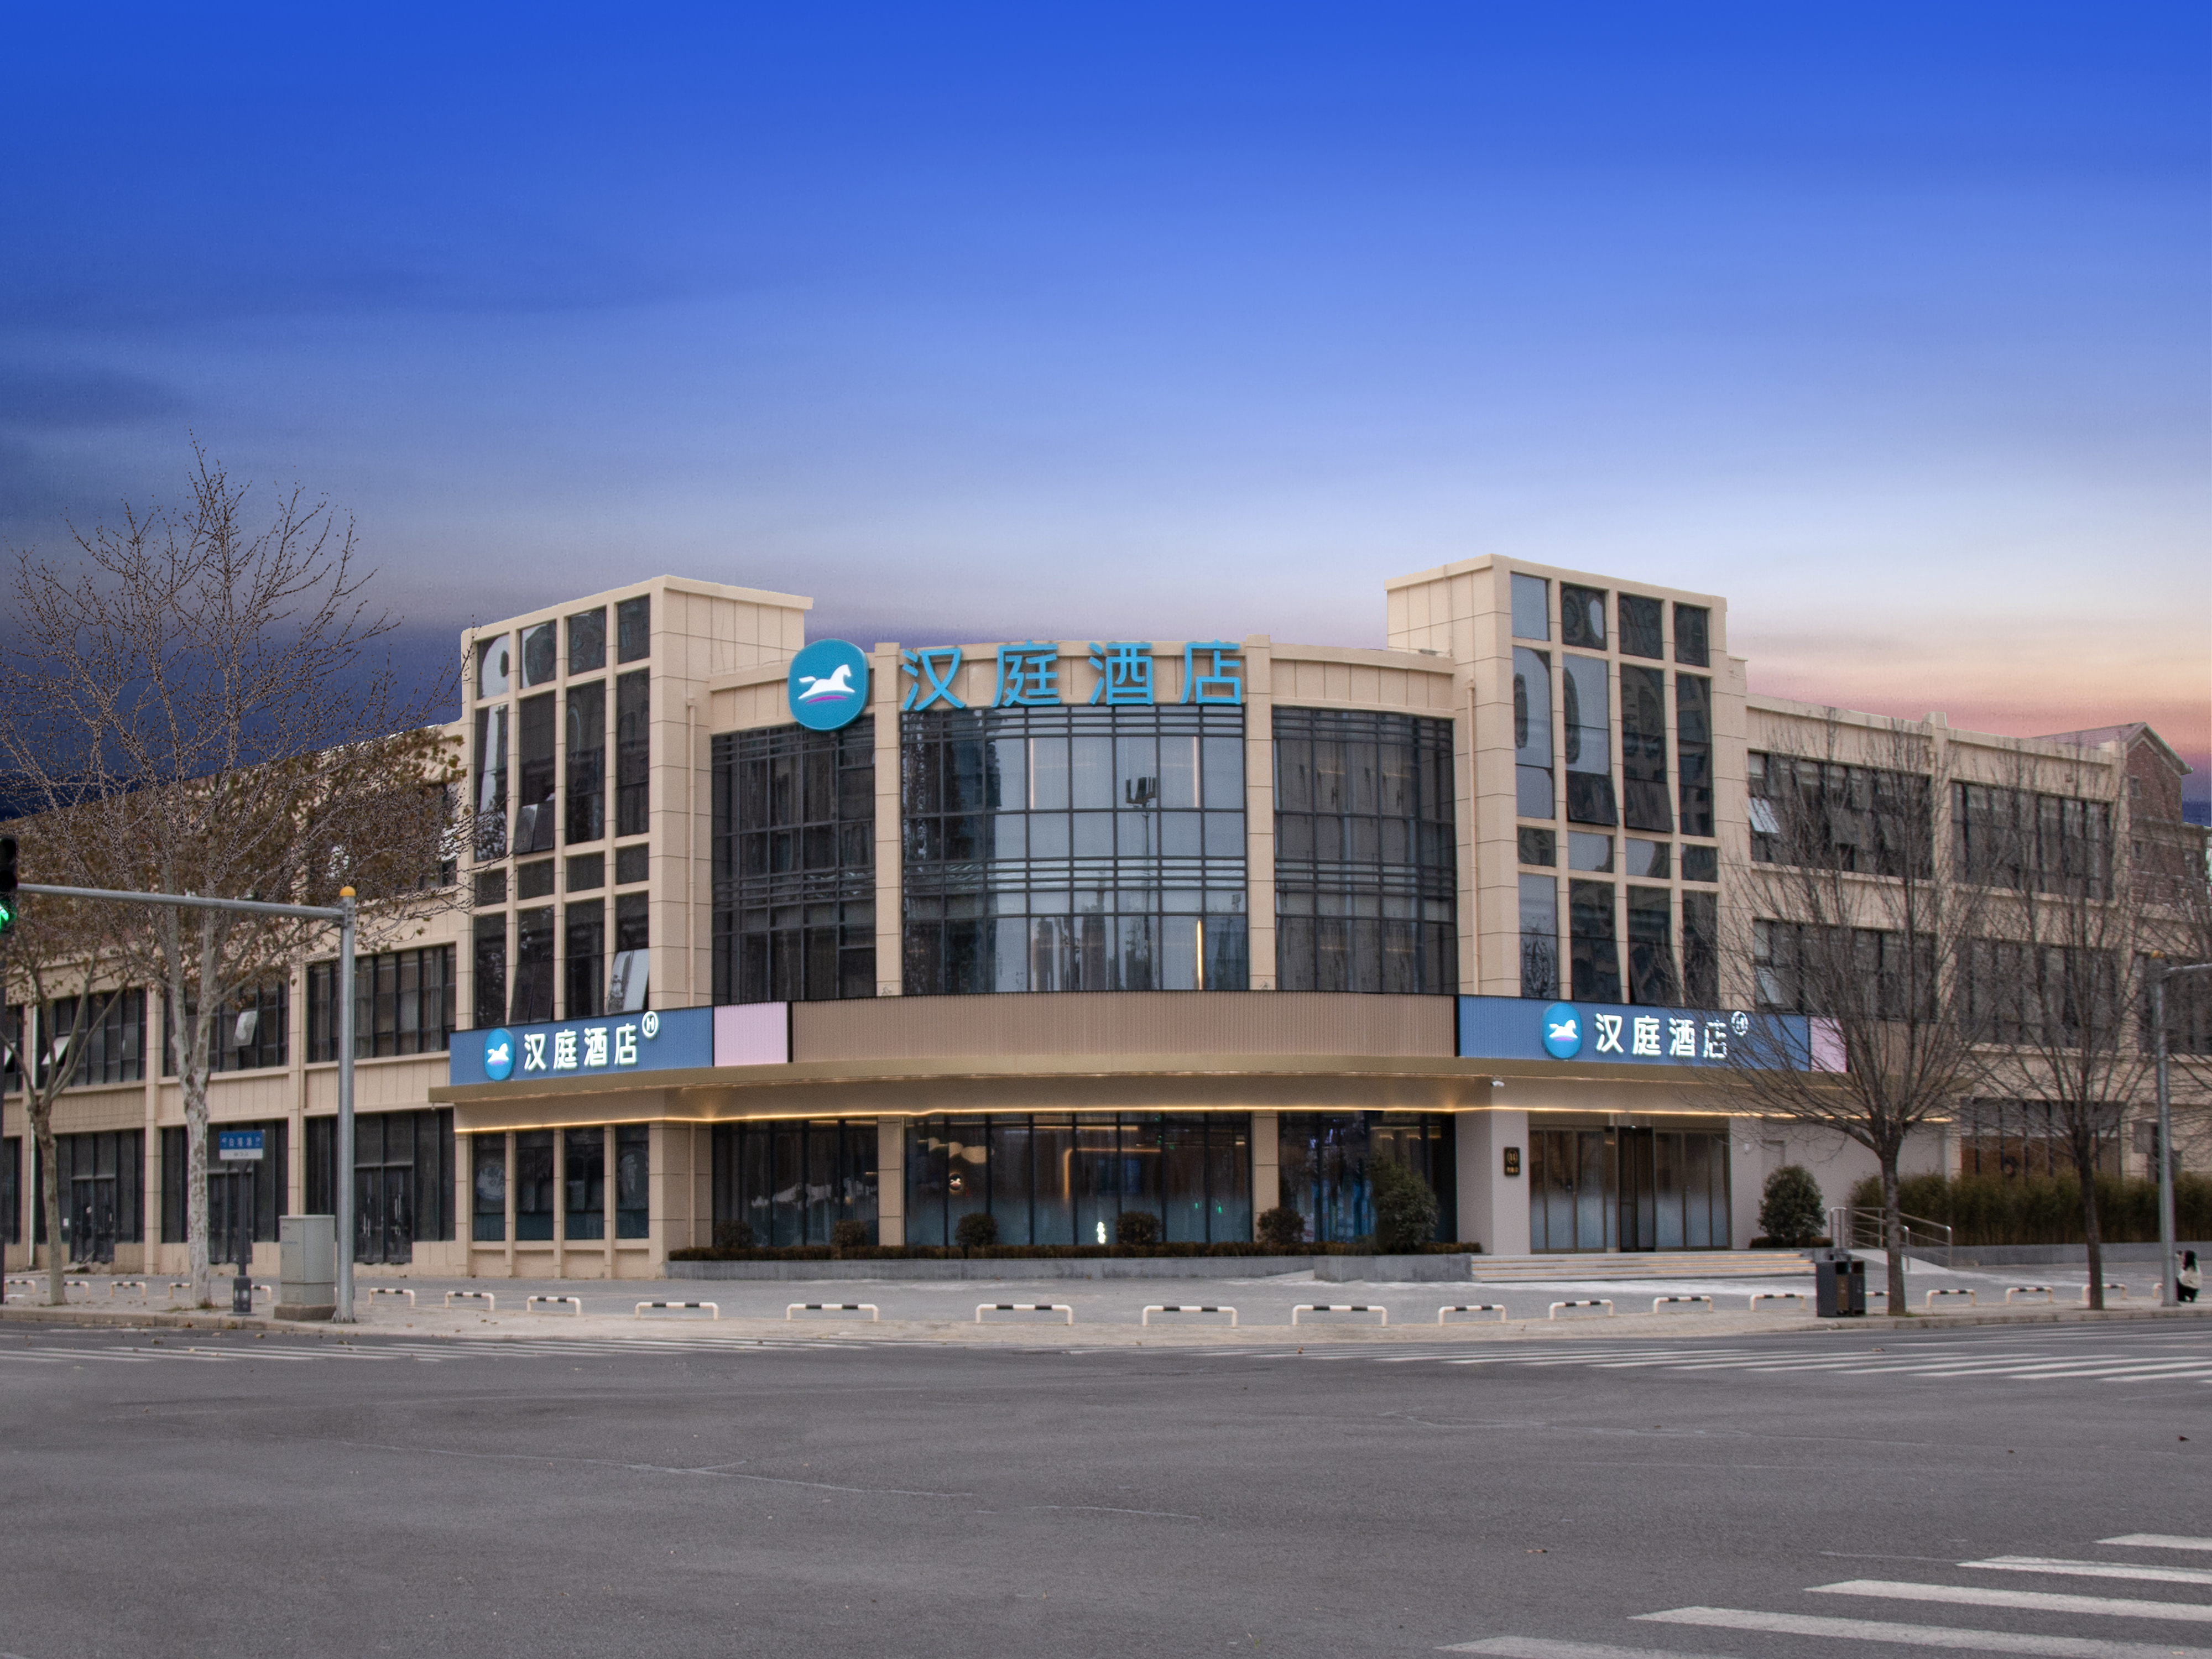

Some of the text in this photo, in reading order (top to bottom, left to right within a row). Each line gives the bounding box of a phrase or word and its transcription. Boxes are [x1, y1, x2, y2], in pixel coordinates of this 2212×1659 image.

[902, 639, 1241, 711] 汉庭酒店
[524, 1023, 637, 1071] 汉庭酒店
[1595, 1013, 1728, 1059] 汉庭酒店
